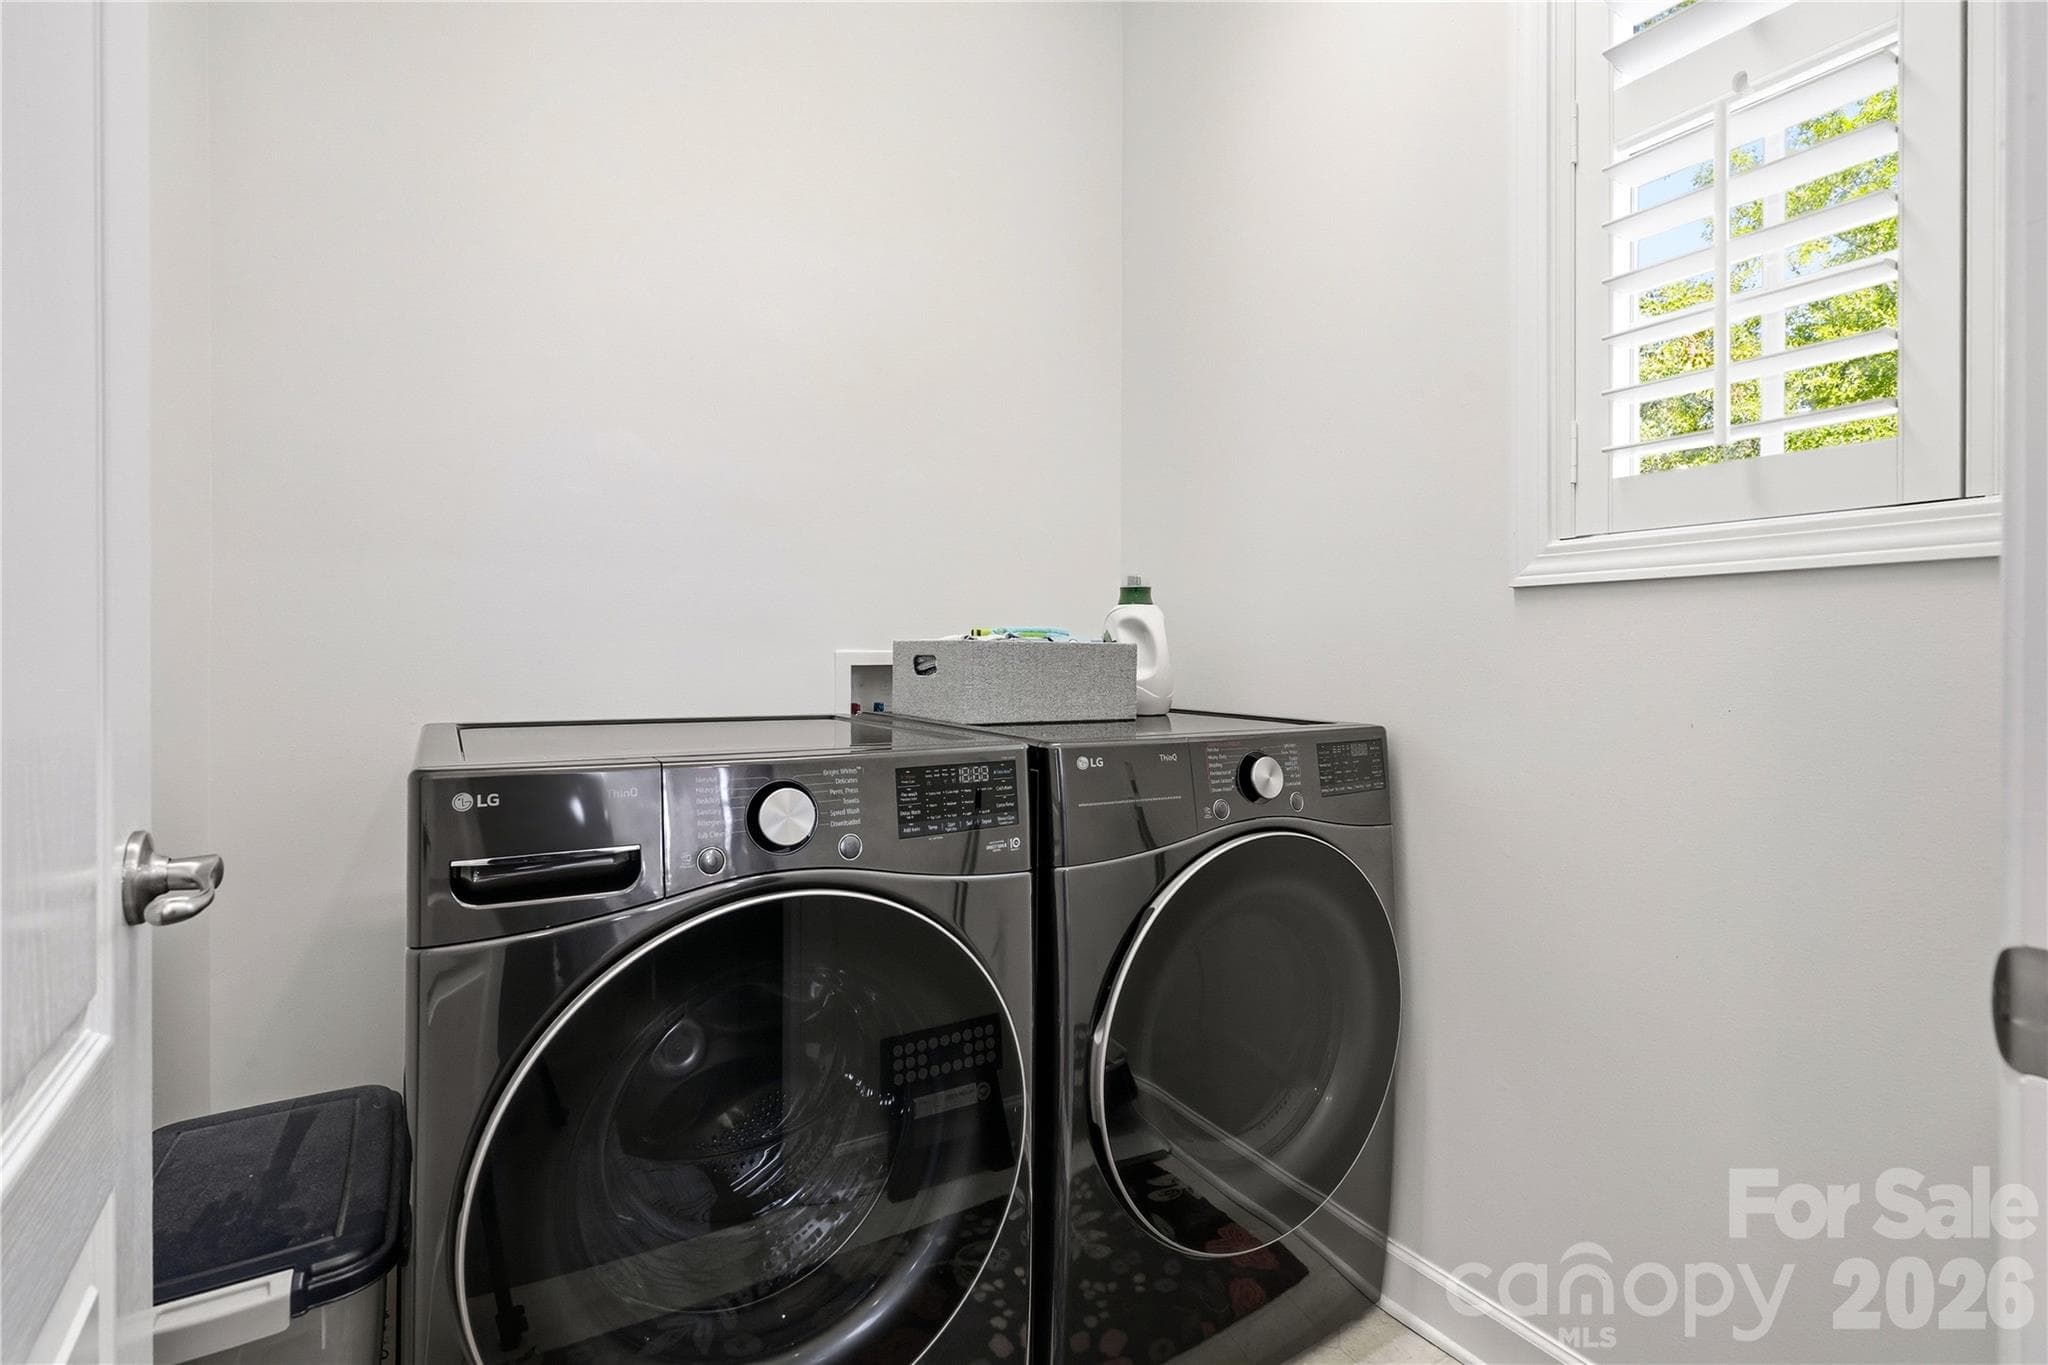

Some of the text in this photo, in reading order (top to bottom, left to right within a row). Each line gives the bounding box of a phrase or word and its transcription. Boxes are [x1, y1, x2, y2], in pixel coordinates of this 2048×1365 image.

[1090, 757, 1104, 768] LG
[1159, 753, 1178, 762] ThinQ
[607, 787, 638, 800] ThinQ
[476, 793, 500, 807] LG
